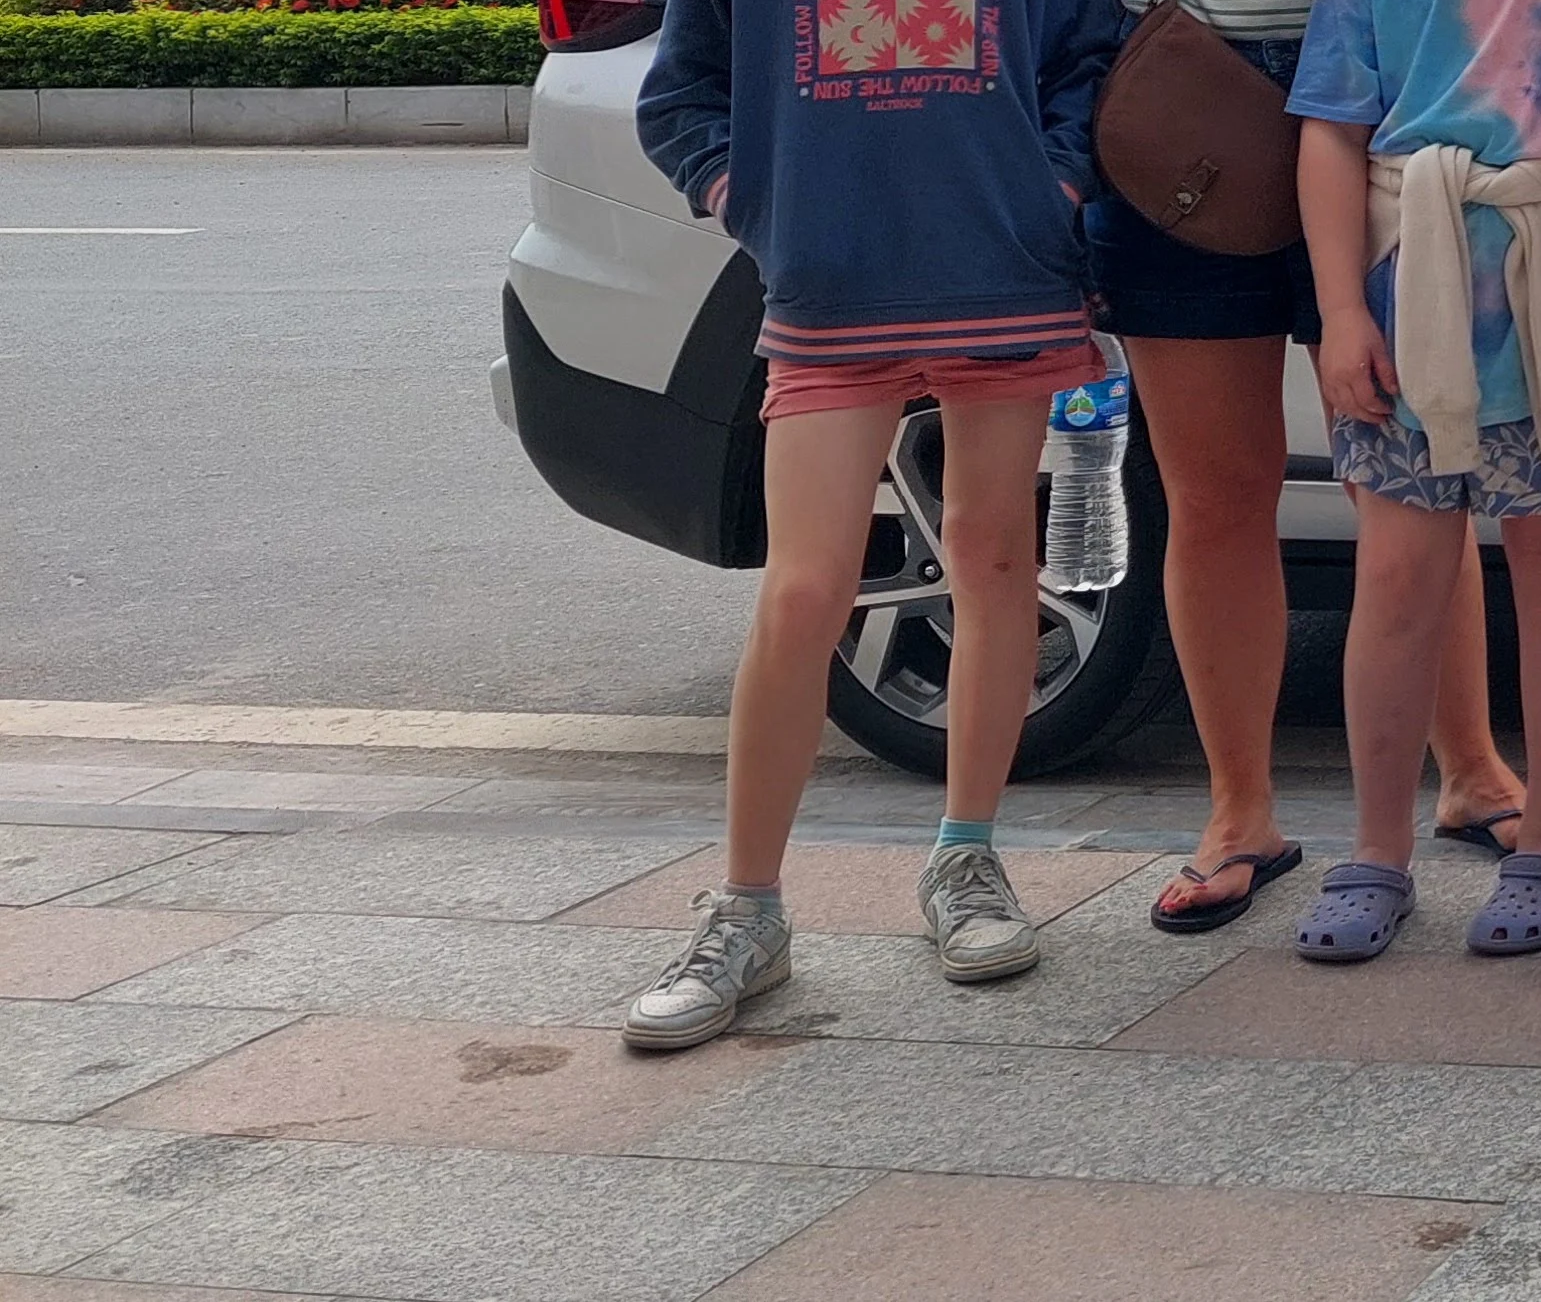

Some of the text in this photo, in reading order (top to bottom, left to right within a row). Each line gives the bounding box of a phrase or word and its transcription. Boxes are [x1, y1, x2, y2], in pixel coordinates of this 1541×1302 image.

[981, 4, 1001, 34] THE
[795, 5, 814, 83] FOLLOW
[981, 36, 999, 77] SUN
[813, 75, 983, 101] FOLLOW THE SUN
